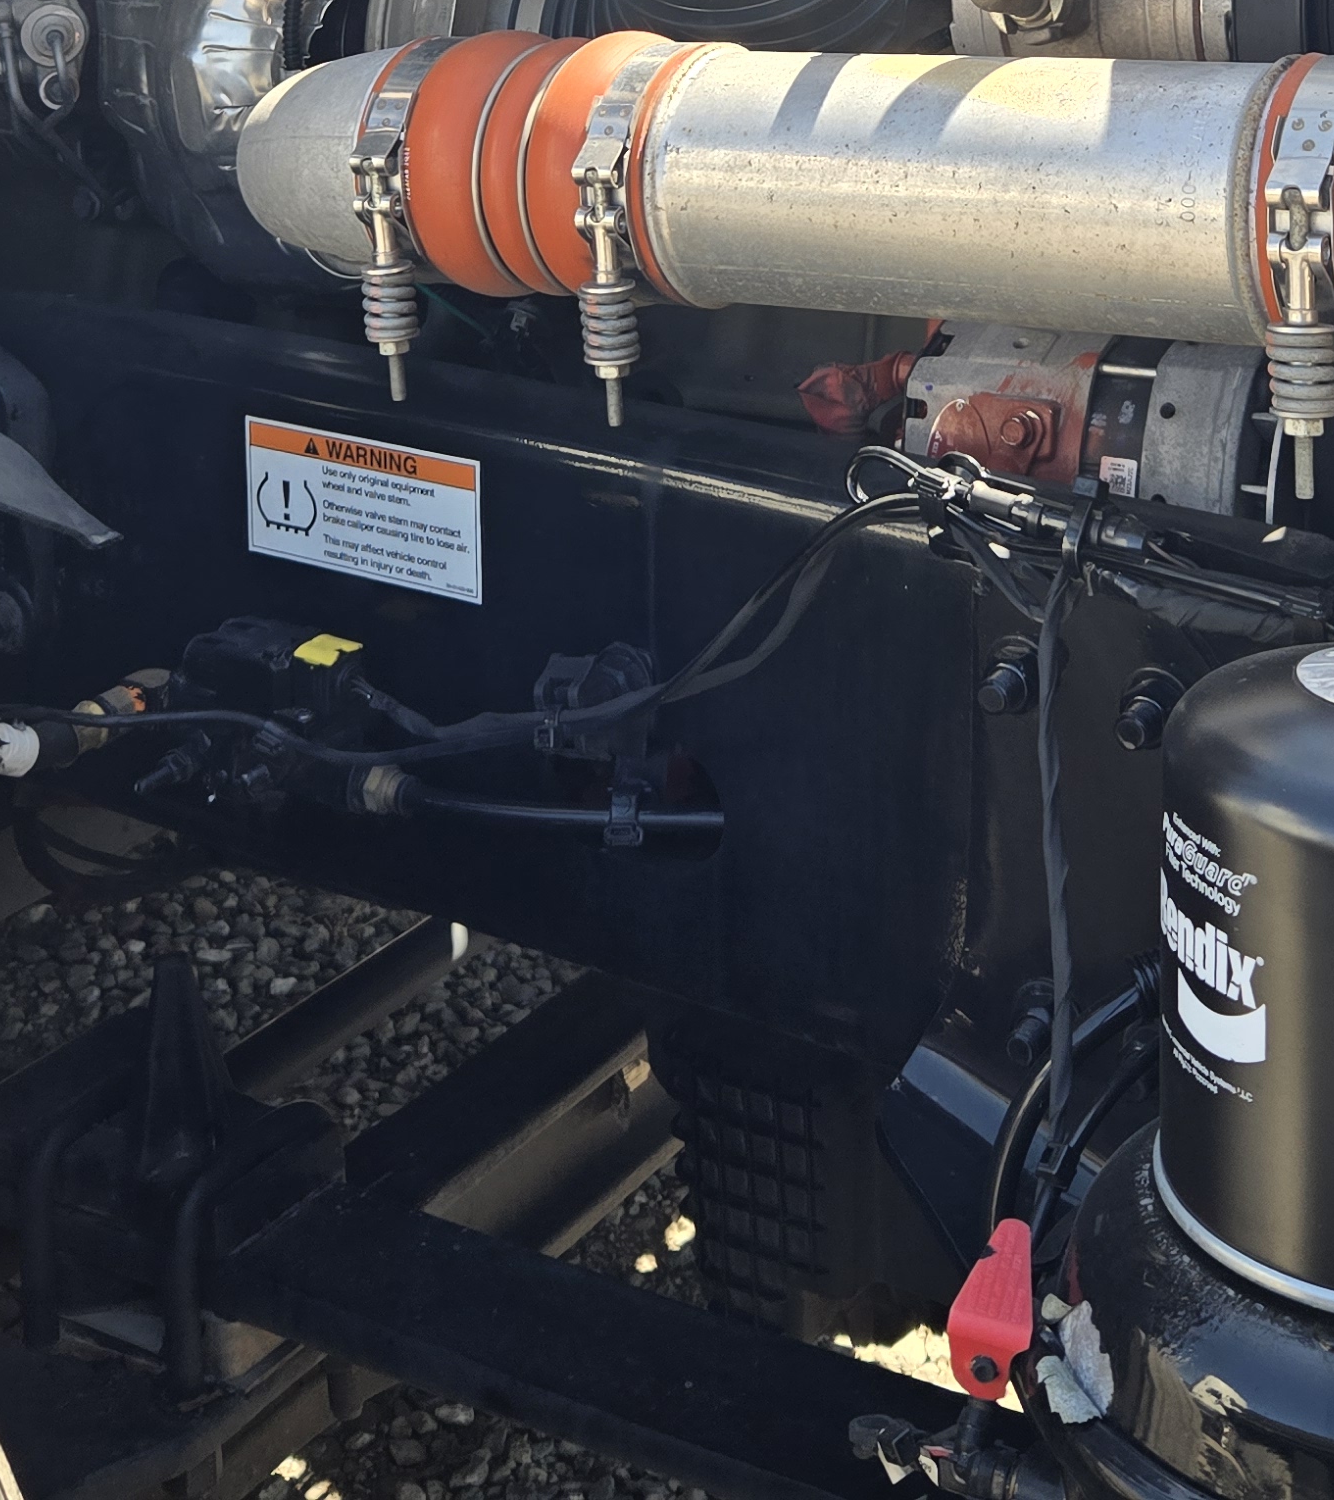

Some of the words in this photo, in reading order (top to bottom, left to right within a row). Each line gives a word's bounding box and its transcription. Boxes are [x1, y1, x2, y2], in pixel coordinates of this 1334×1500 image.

[325, 439, 418, 476] WARNING
[322, 465, 338, 477] Use
[339, 469, 357, 483] only
[358, 473, 389, 489] original
[391, 481, 436, 498] equipment
[322, 480, 345, 493] wheel
[346, 484, 362, 496] and
[364, 489, 386, 501] valve
[387, 493, 411, 507] stem.
[322, 499, 363, 517] Otherwise
[364, 510, 387, 522] valve
[388, 515, 409, 527] stem
[410, 521, 428, 533] may
[429, 524, 462, 539] contact
[322, 512, 346, 526] brake
[347, 518, 375, 532] caliper
[376, 526, 409, 542] causing
[410, 532, 425, 544] tire
[425, 536, 435, 546] to
[436, 538, 455, 550] lose
[455, 542, 471, 555] air.
[323, 533, 341, 546] This
[342, 540, 360, 553] may
[361, 543, 385, 557] affect
[385, 549, 416, 563] vehicle
[417, 556, 447, 570] control
[323, 549, 359, 566] resulting
[360, 556, 368, 566] in
[370, 558, 394, 574] injury
[395, 565, 405, 574] or
[406, 567, 433, 582] death.
[1180, 860, 1241, 917] Technology
[1160, 866, 1258, 1010] Bendix
